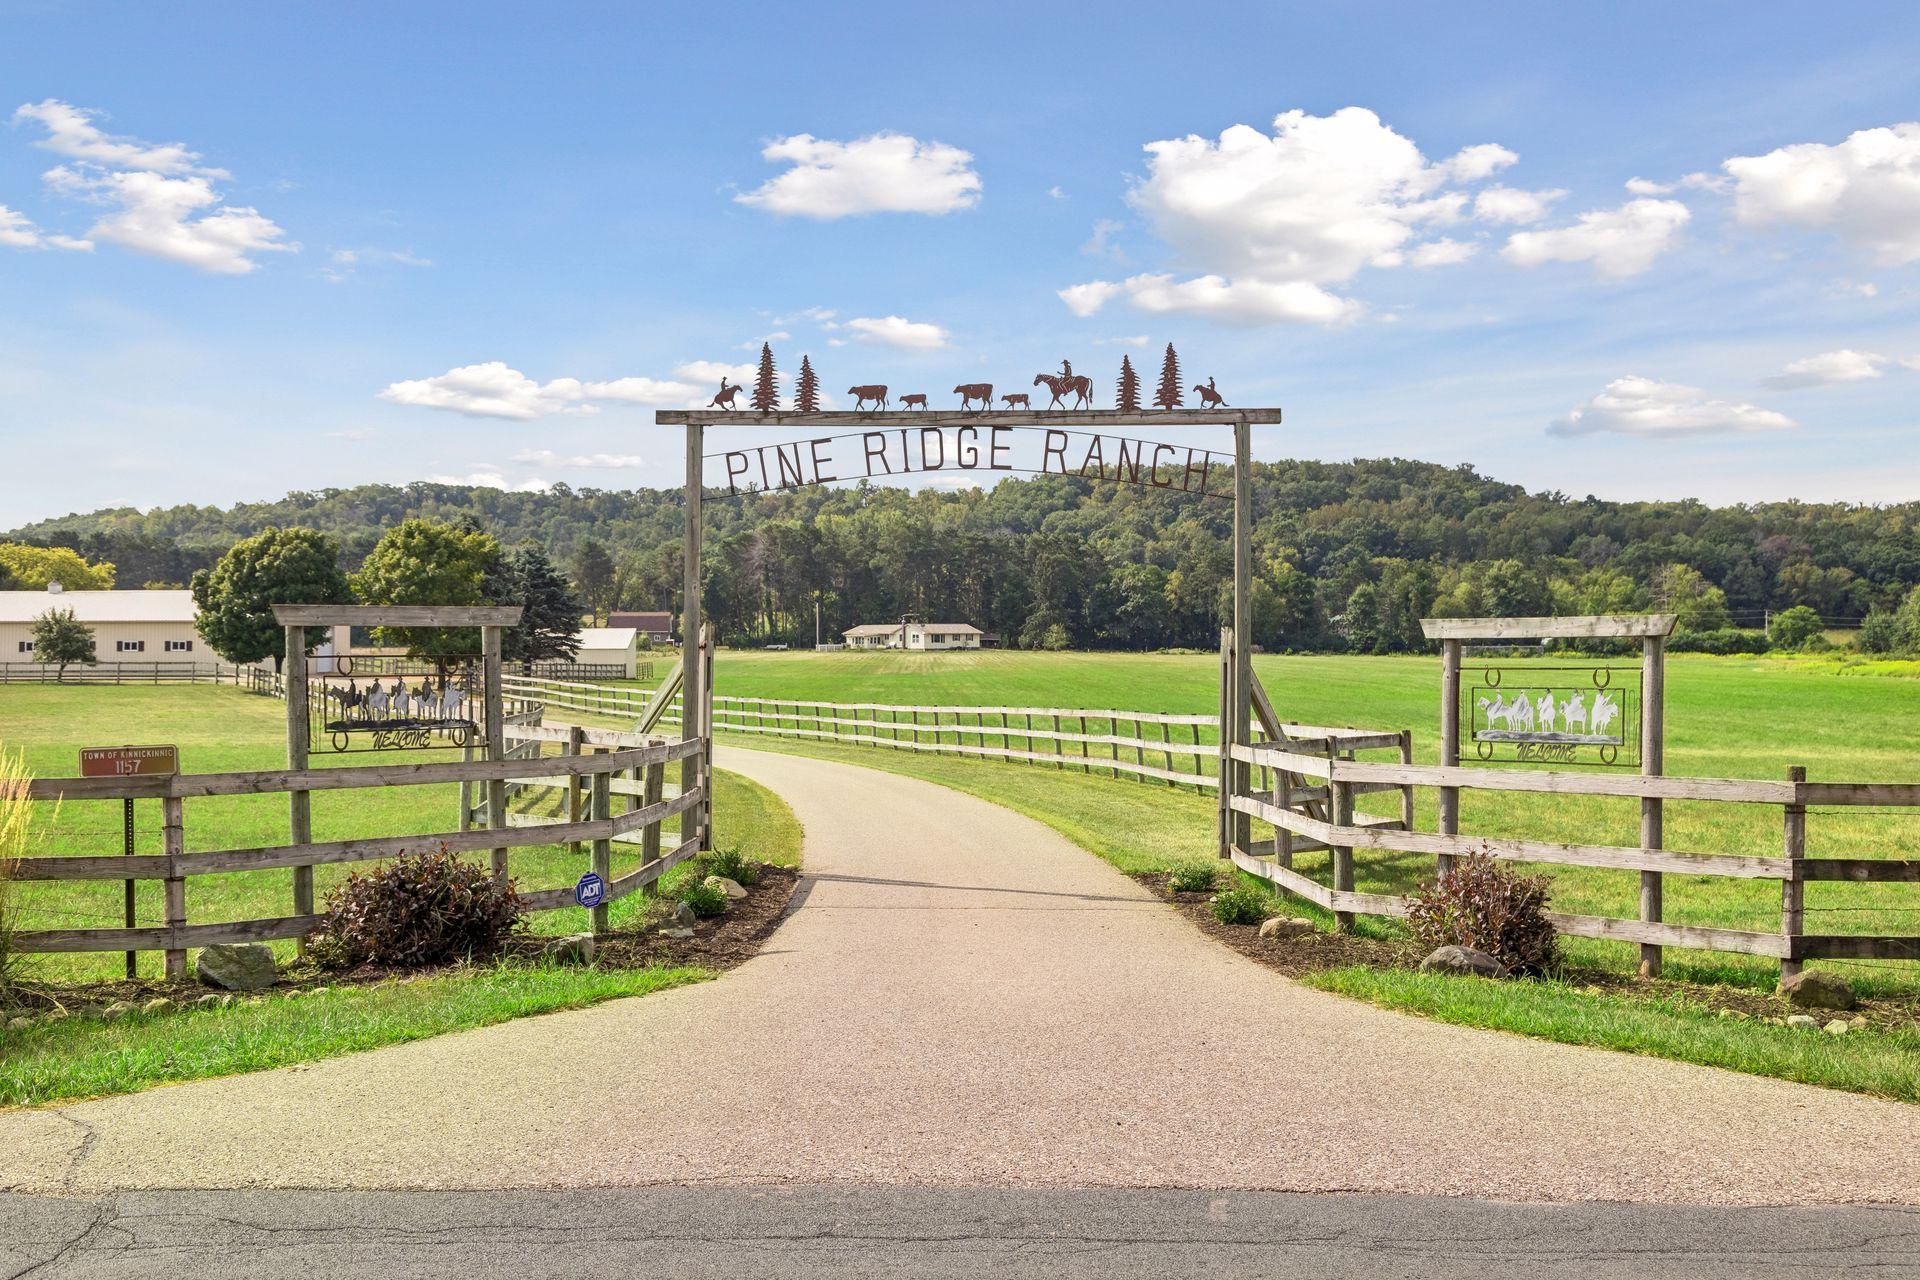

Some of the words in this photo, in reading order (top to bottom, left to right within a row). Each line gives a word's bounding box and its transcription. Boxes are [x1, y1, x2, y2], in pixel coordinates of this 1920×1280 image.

[726, 438, 837, 494] PINE
[863, 426, 1013, 476] RIDGE
[1042, 430, 1211, 492] RANCH
[372, 731, 431, 749] WELCOME
[84, 752, 105, 760] TOWN
[107, 751, 117, 759] OF
[1516, 743, 1577, 763] WELCOME
[115, 760, 141, 774] 1157
[582, 882, 600, 898] ADT
